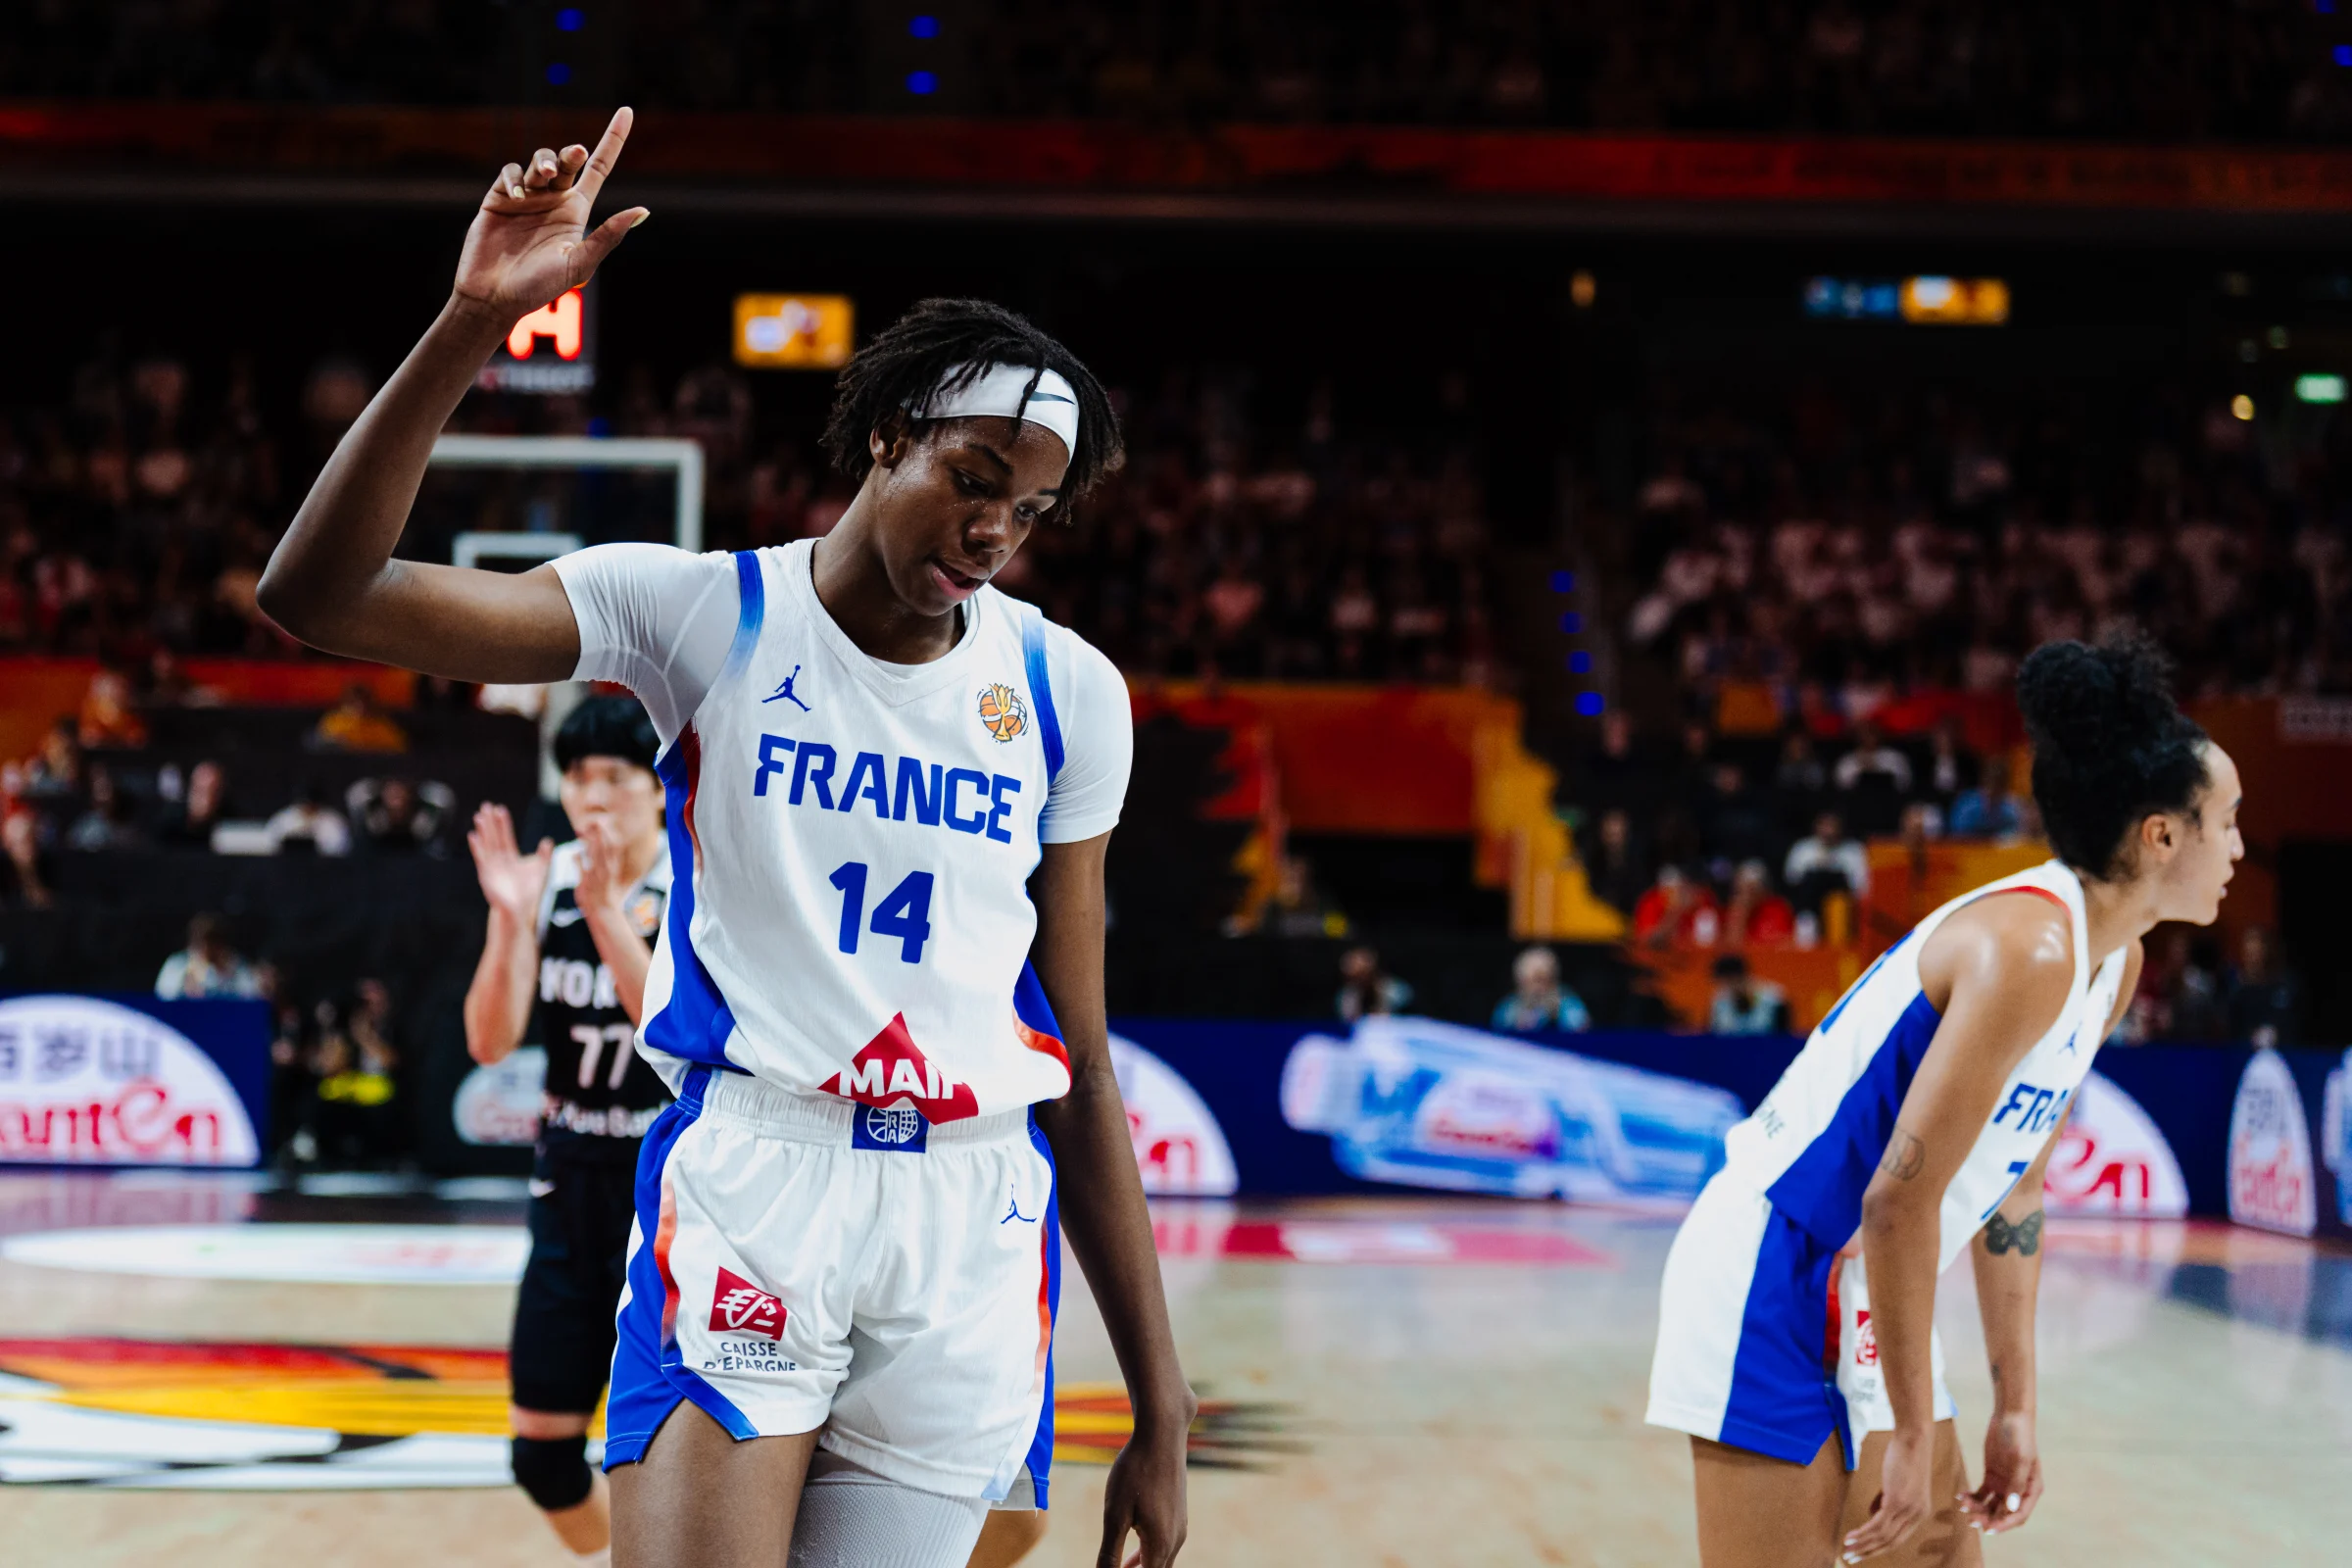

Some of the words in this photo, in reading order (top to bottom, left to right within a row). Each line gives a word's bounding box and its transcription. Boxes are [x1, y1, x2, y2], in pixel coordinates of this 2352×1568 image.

[754, 733, 1021, 844] FRANCE
[829, 861, 934, 964] 14
[569, 1023, 634, 1089] 77
[720, 1342, 777, 1356] CAISSE
